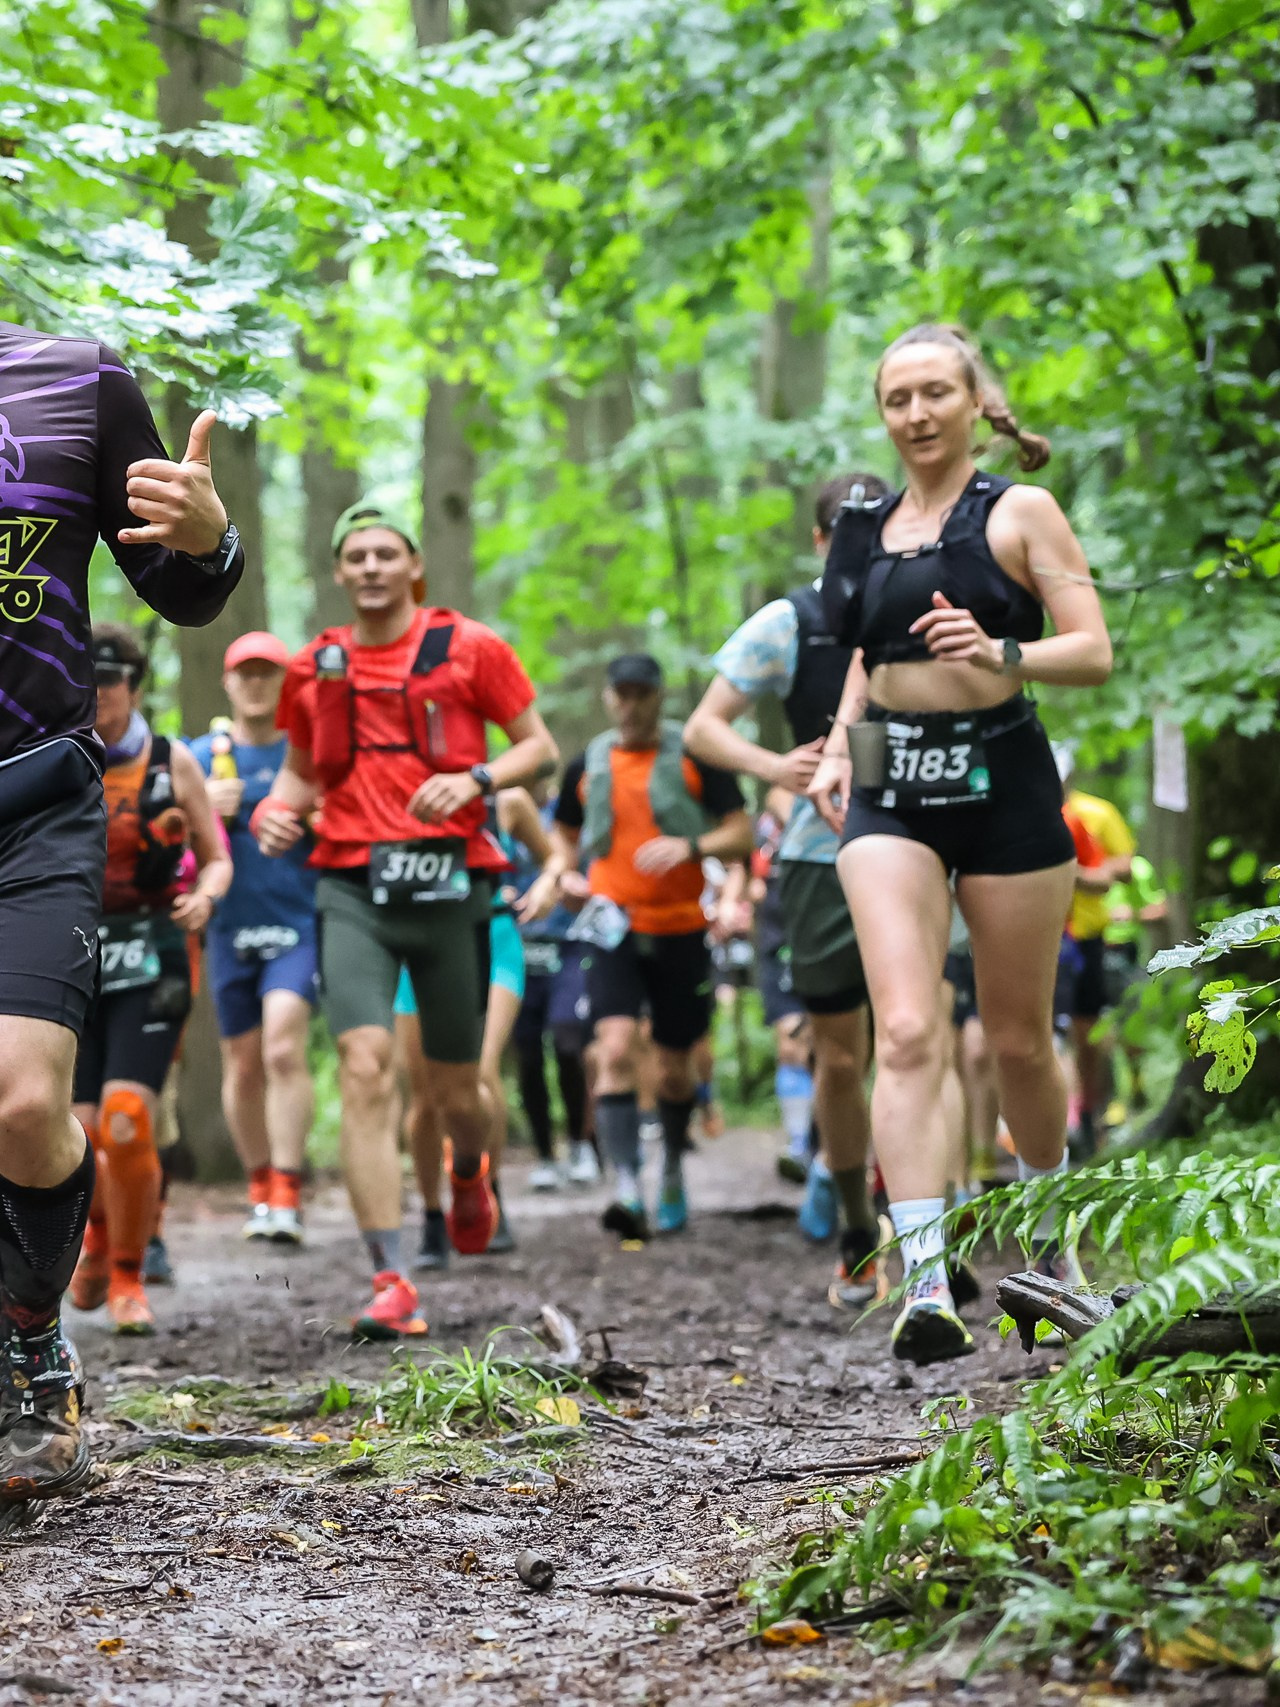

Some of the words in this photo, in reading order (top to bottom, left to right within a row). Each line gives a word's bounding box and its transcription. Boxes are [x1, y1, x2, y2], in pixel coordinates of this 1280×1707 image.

[888, 743, 972, 782] 3183
[380, 851, 454, 882] 3101
[100, 938, 145, 972] 76
